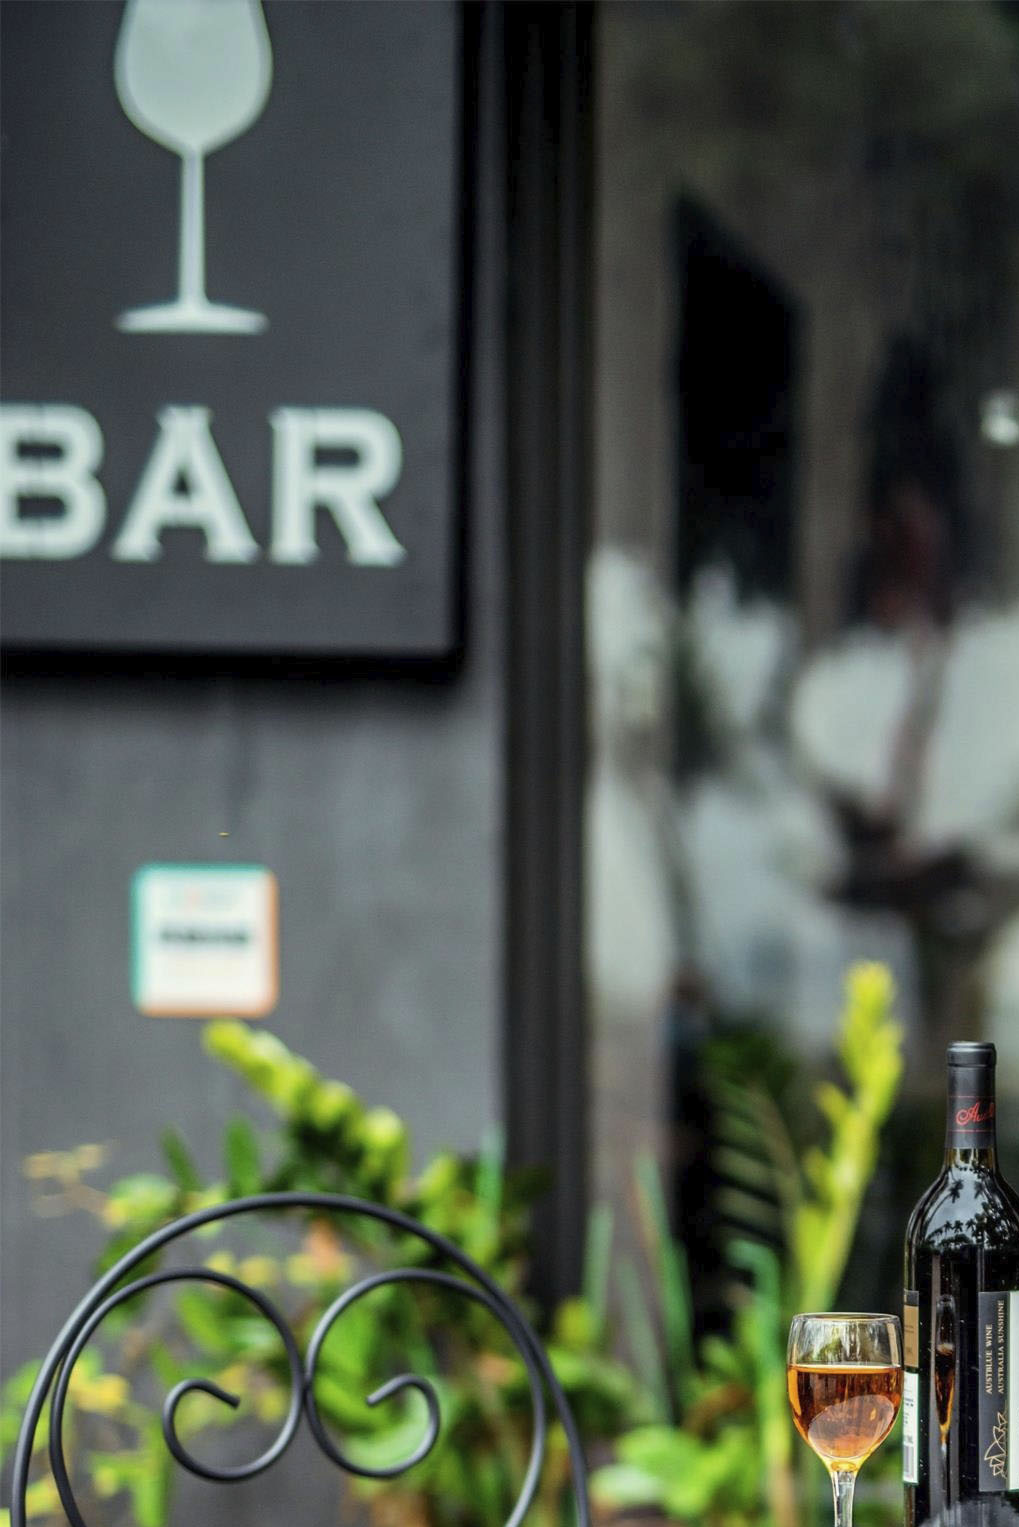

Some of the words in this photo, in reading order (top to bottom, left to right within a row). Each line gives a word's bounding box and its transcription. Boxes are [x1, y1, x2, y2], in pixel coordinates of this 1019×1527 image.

[0, 403, 406, 566] BAR
[985, 1324, 993, 1347] WINE
[997, 1300, 1005, 1343] SUNSHINE
[985, 1350, 993, 1395] AUSTBLUE
[997, 1346, 1005, 1395] AUSTRALIA
